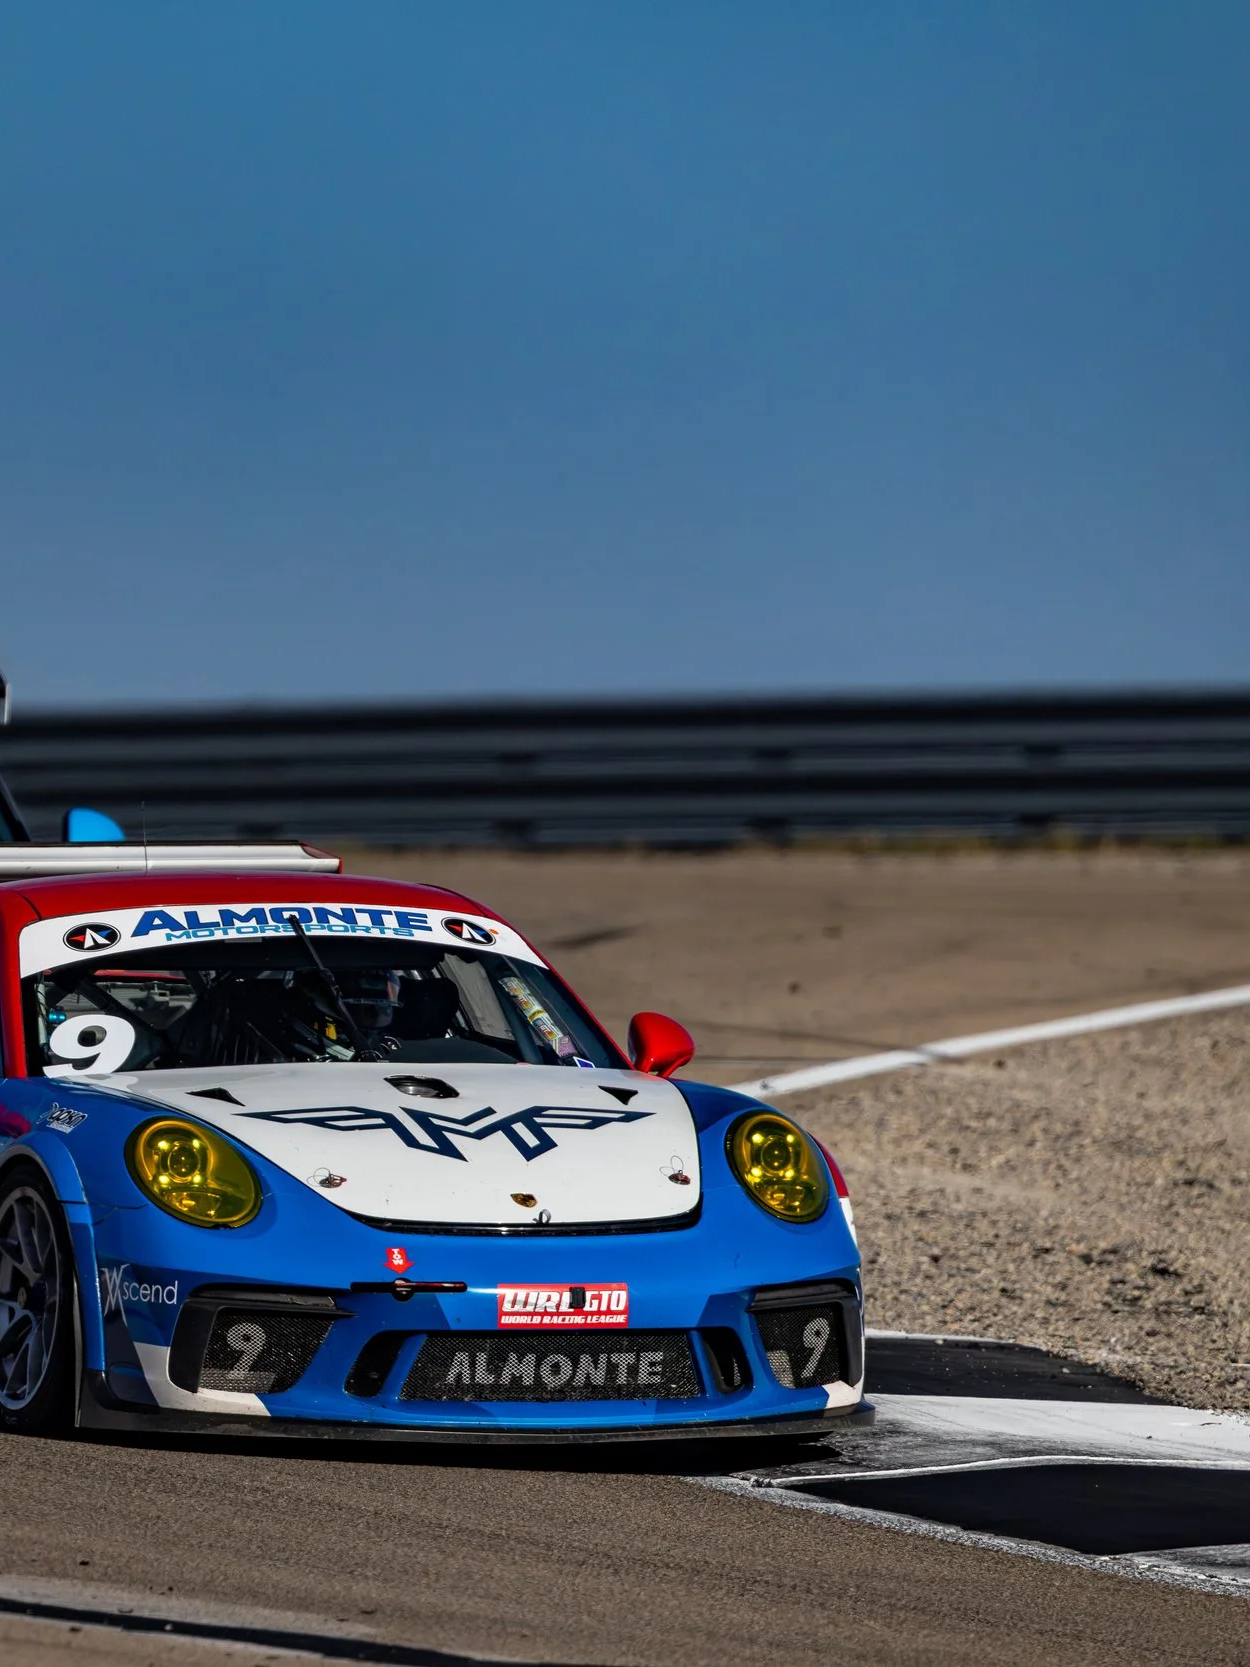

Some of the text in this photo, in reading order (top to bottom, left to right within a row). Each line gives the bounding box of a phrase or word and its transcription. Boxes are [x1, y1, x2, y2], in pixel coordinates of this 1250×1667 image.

[130, 907, 432, 937] ALMONTE
[165, 924, 414, 941] MOTORSPORTS
[42, 1014, 135, 1078] 9
[391, 1248, 404, 1265] TOW
[502, 1290, 627, 1312] WRL GTO
[500, 1315, 627, 1324] WORLD RACING LEAGUE
[227, 1322, 267, 1379] 9
[800, 1317, 830, 1378] 9
[446, 1351, 664, 1387] ALMONTE
